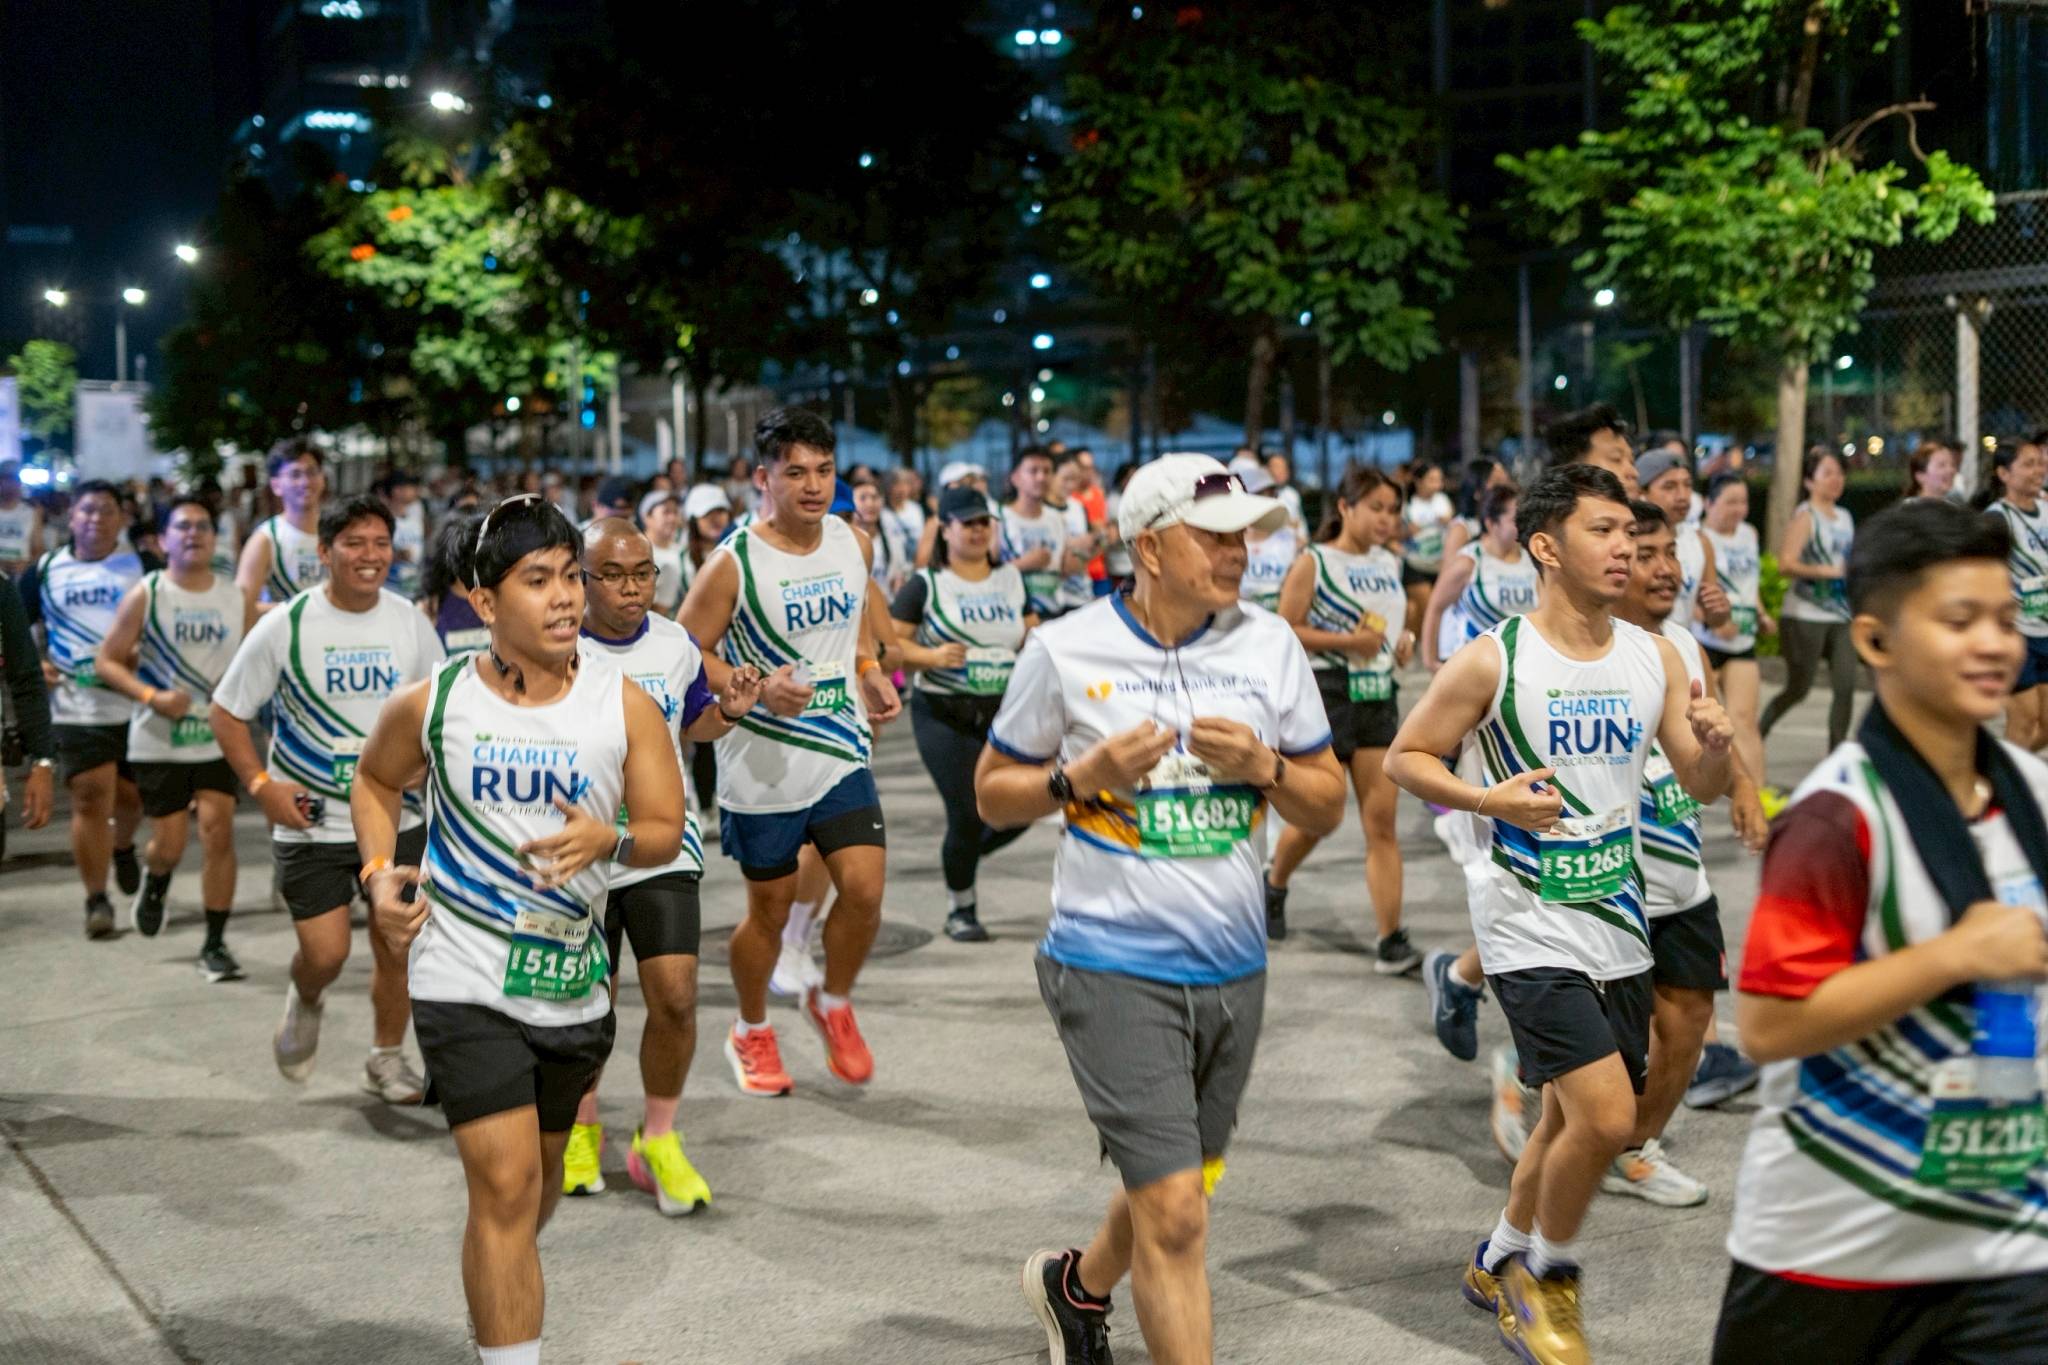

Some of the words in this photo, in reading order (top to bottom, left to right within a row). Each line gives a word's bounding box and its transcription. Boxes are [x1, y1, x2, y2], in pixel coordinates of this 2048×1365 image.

[783, 577, 844, 600] CHARITY
[1349, 575, 1397, 592] RUN
[65, 586, 117, 606] RUN
[785, 591, 849, 631] RUN
[961, 606, 1014, 623] RUN
[175, 622, 224, 641] RUN
[325, 652, 391, 665] CHARITY
[326, 666, 394, 693] RUN
[1548, 698, 1631, 717] CHARITY
[1548, 718, 1633, 755] RUN
[473, 745, 578, 767] CHARITY
[472, 765, 579, 805] RUN
[1154, 798, 1240, 833] 51682
[1555, 845, 1623, 879] 51263
